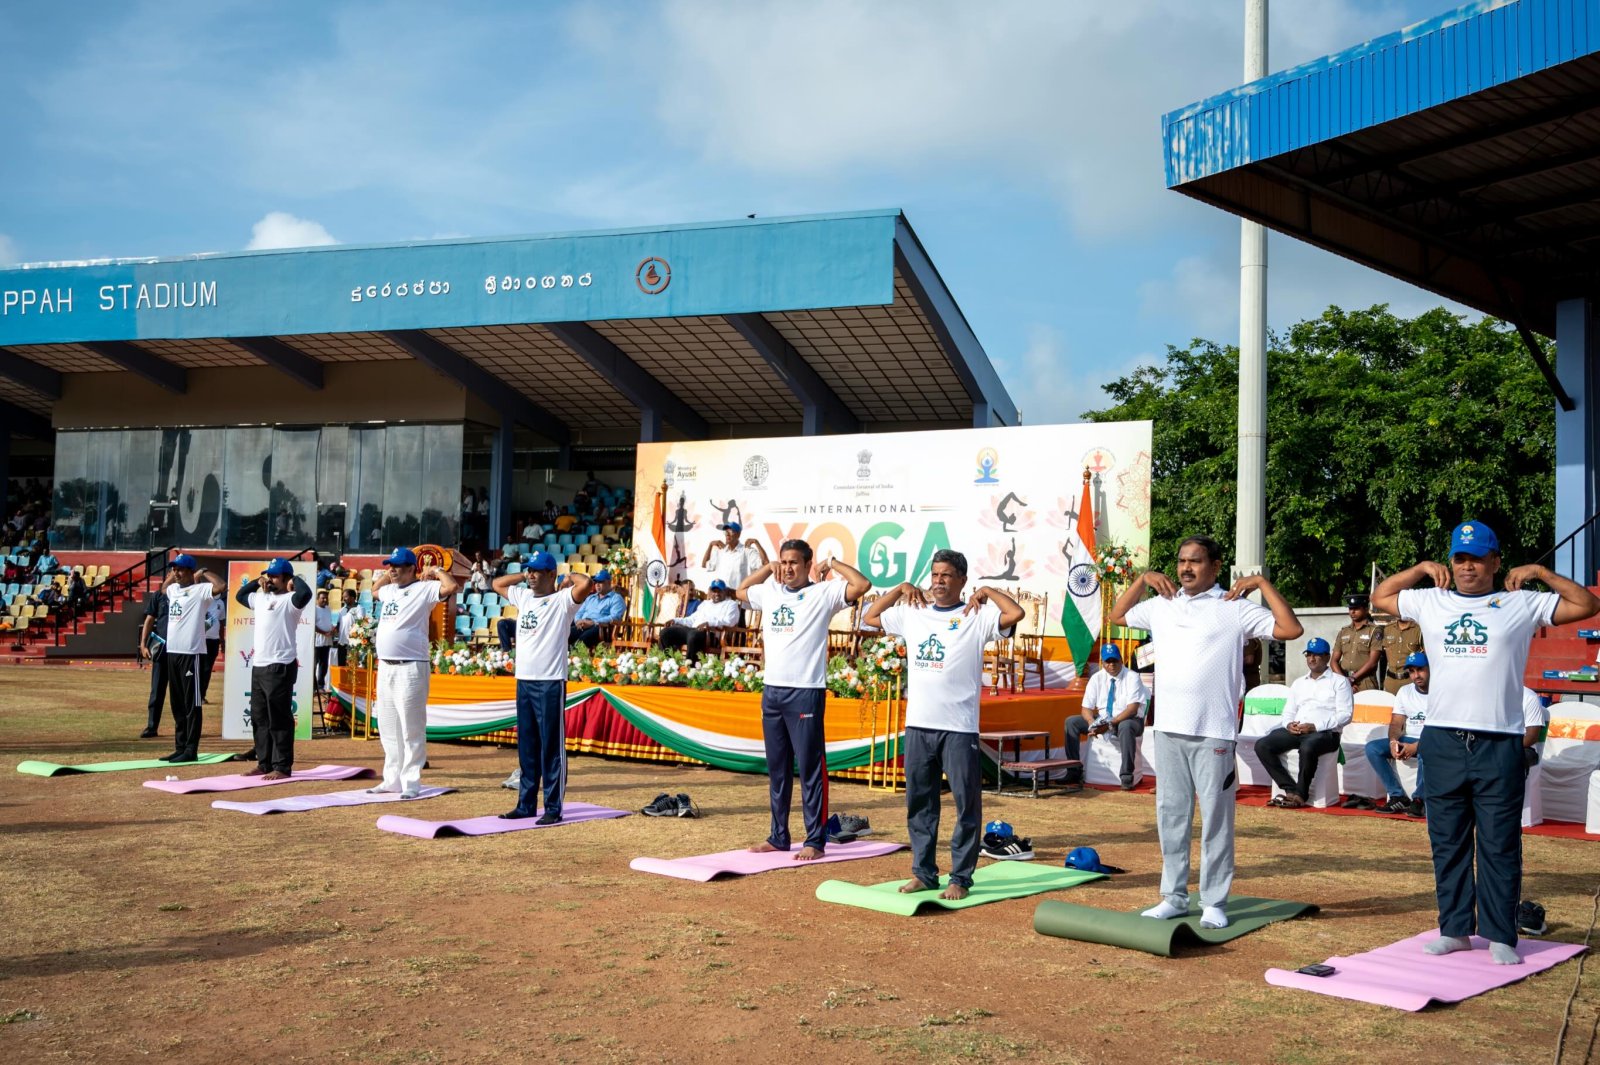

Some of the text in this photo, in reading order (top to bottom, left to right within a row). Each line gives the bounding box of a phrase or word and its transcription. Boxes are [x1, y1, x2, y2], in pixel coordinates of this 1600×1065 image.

[4, 281, 217, 315] PPAH STADIUM
[804, 504, 916, 513] INTERNATIONAL
[1444, 612, 1489, 645] 365
[1443, 645, 1488, 655] Yoga 365
